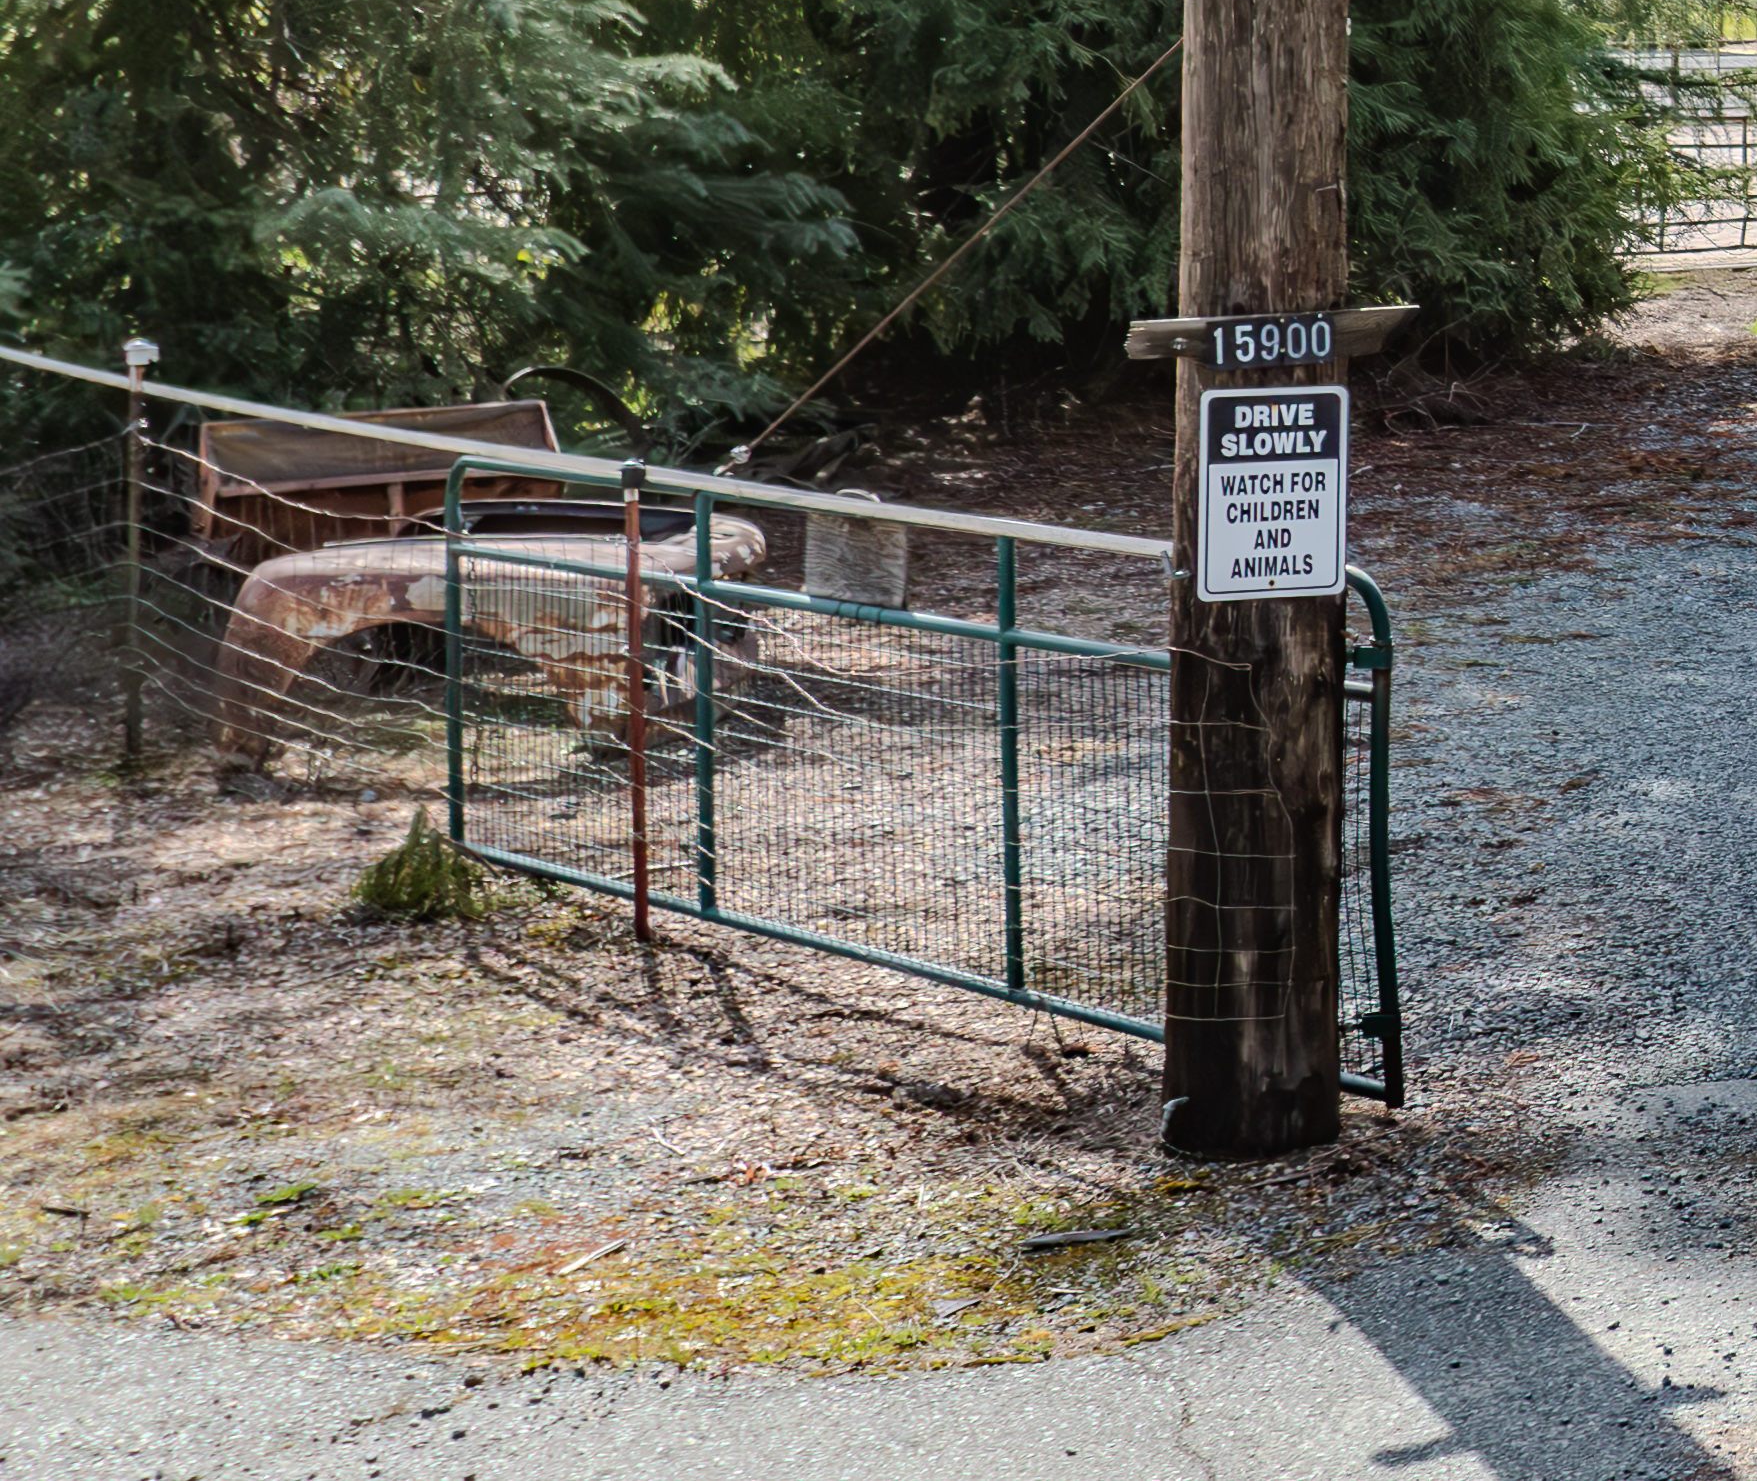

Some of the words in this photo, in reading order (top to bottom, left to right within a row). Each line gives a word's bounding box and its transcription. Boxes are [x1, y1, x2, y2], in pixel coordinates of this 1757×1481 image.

[1213, 321, 1331, 364] 15900
[1235, 404, 1314, 428] DRIVE
[1221, 430, 1327, 457] SLOWLY
[1221, 473, 1284, 496] WATCH
[1291, 471, 1326, 493] FOR
[1226, 499, 1320, 523] CHILDREN
[1254, 528, 1292, 549] AND
[1231, 554, 1313, 578] ANIMALS
